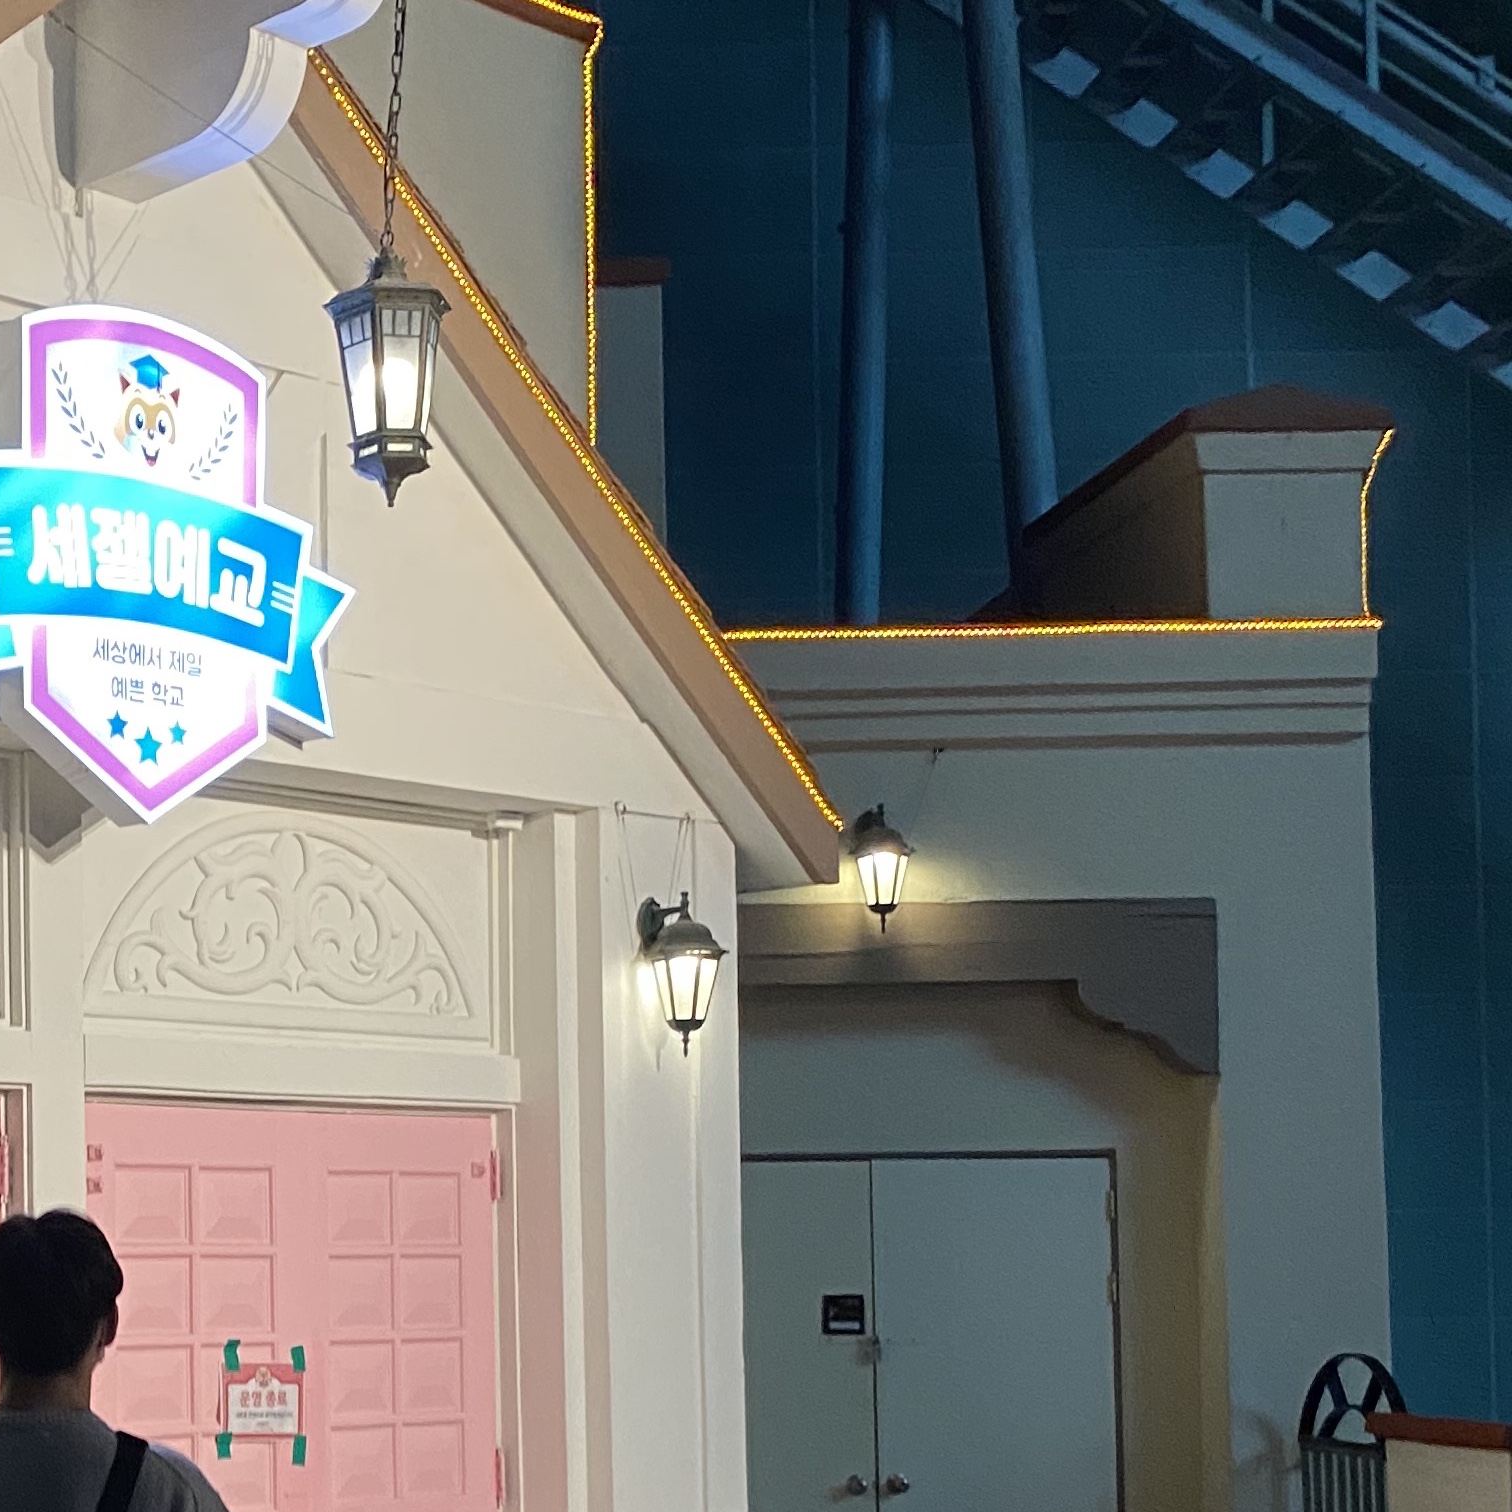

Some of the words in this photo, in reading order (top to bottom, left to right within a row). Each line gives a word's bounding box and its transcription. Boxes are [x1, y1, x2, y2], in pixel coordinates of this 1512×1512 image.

[28, 504, 267, 627] 세젤예교
[93, 637, 162, 669] 세상에서
[169, 650, 202, 677] 제일
[111, 676, 145, 703] 예쁜
[152, 681, 185, 707] 학교
